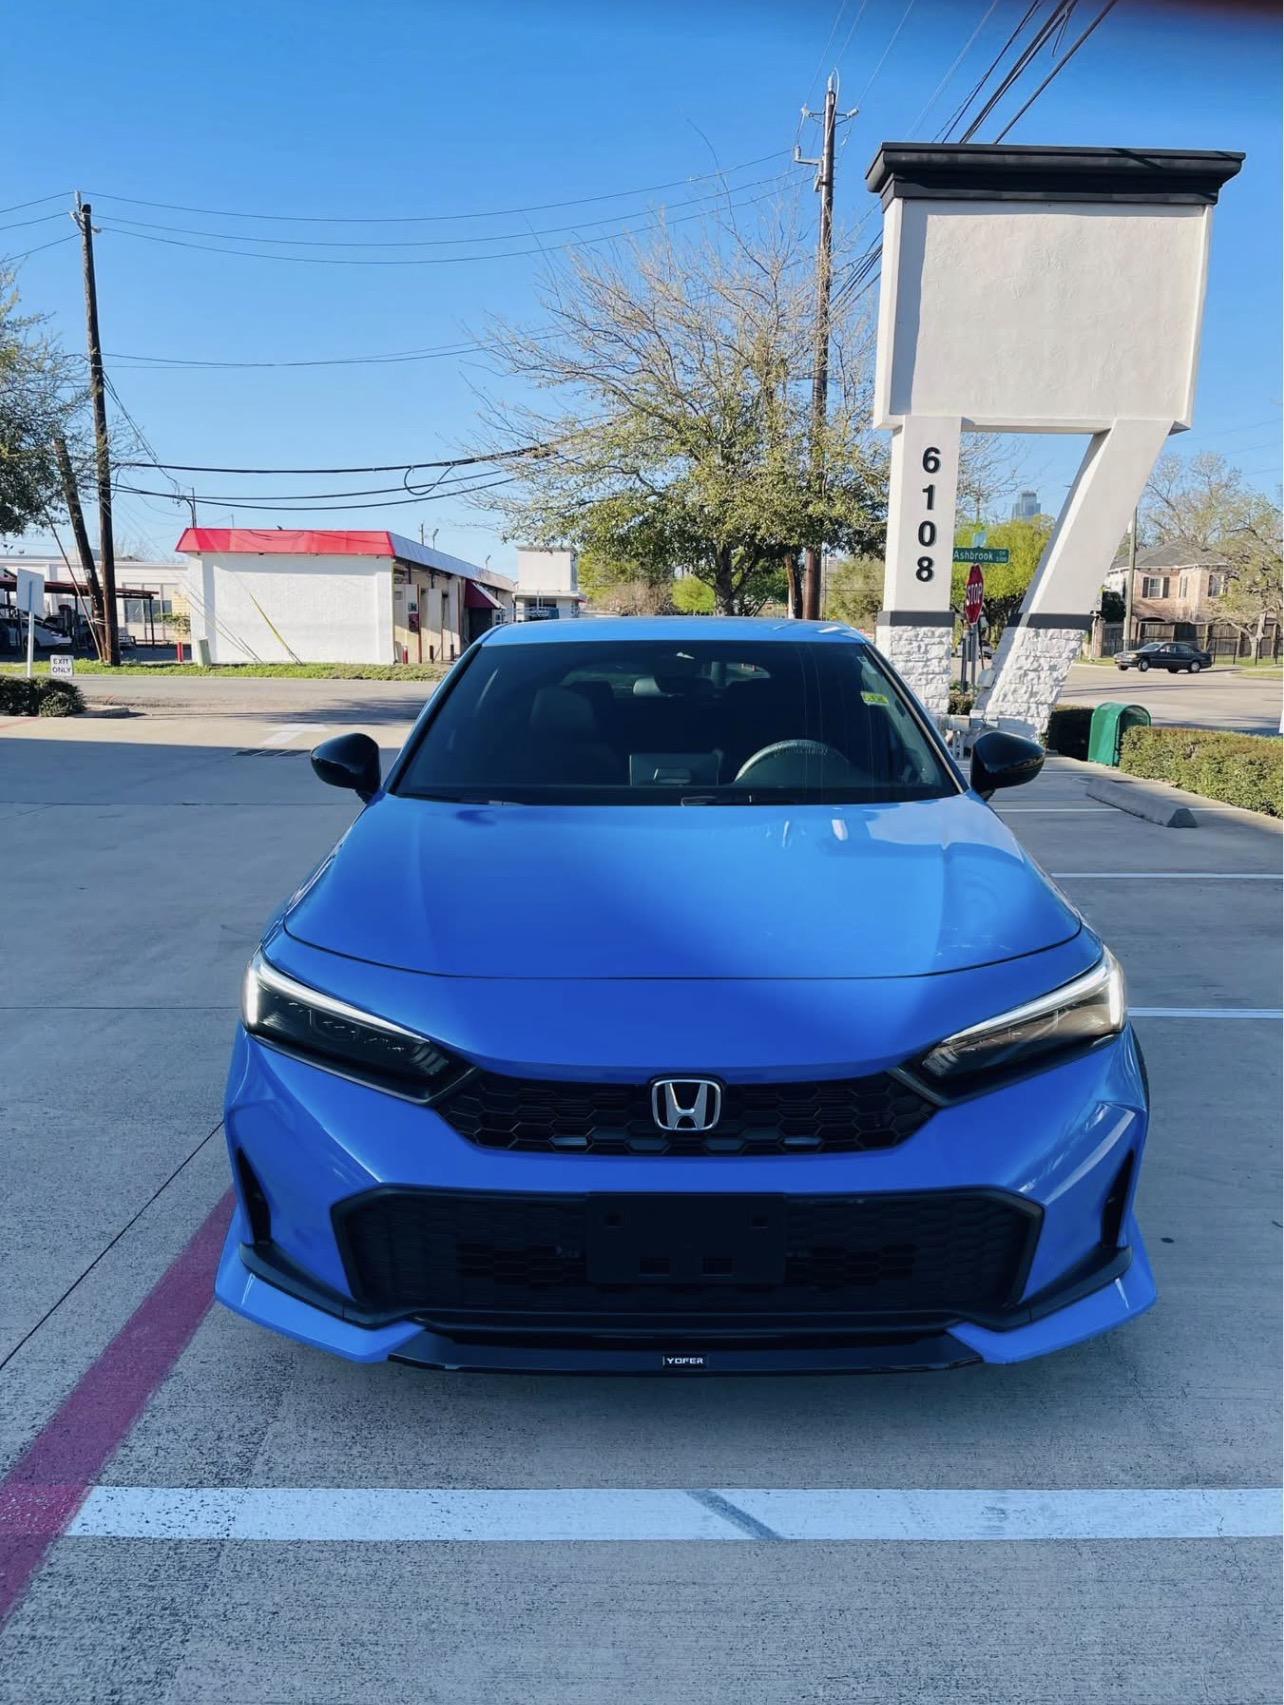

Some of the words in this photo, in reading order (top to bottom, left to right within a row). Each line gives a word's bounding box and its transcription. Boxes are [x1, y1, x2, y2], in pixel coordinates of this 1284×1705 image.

[916, 447, 941, 582] 6108
[953, 550, 993, 561] Ashbrook
[966, 582, 983, 606] STOP
